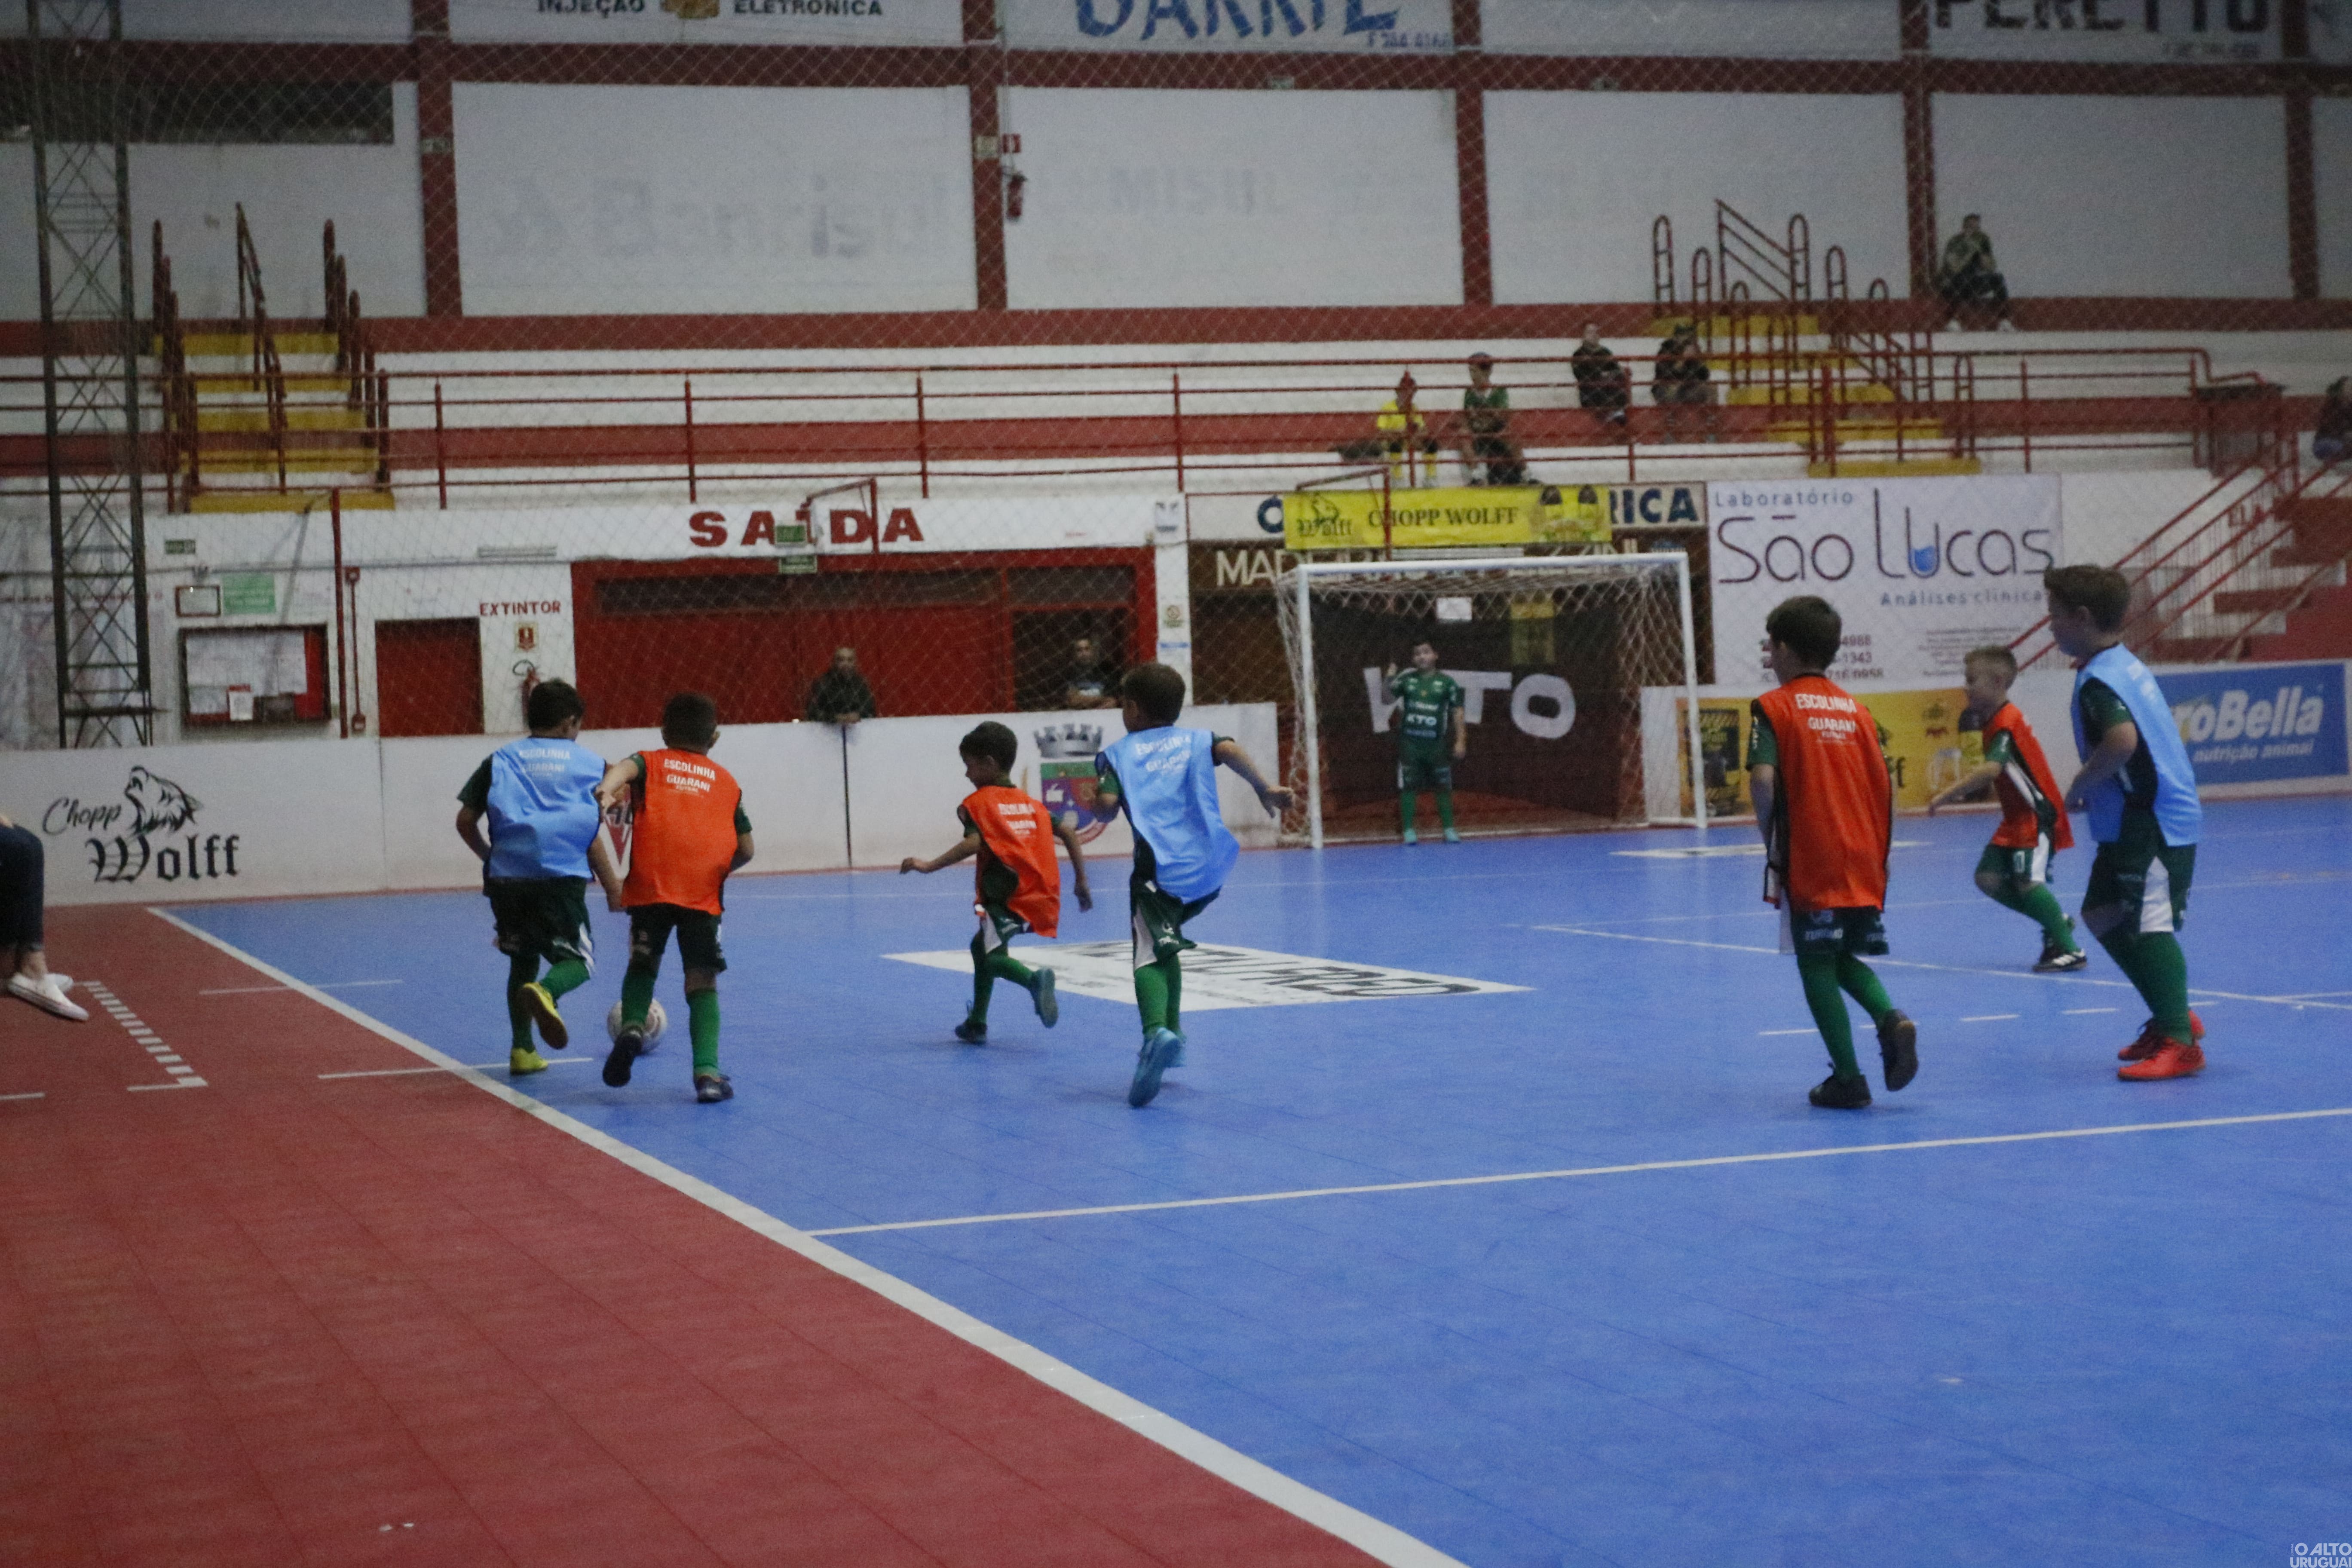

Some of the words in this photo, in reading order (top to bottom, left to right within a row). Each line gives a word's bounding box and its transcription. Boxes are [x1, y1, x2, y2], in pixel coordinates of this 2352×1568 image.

[1715, 488, 1854, 506] Laboratório
[1368, 509, 1439, 527] CHOPP
[1718, 514, 1855, 583] São
[1881, 591, 1967, 606] Análises
[479, 600, 561, 616] EXTINTOR
[1795, 694, 1857, 713] ESCOLINHA
[1808, 717, 1856, 732] GUARANI
[664, 759, 716, 781] ESCOLINHA
[667, 775, 710, 792] GUARANI
[43, 798, 122, 835] Chopp
[86, 834, 240, 882] Wolff
